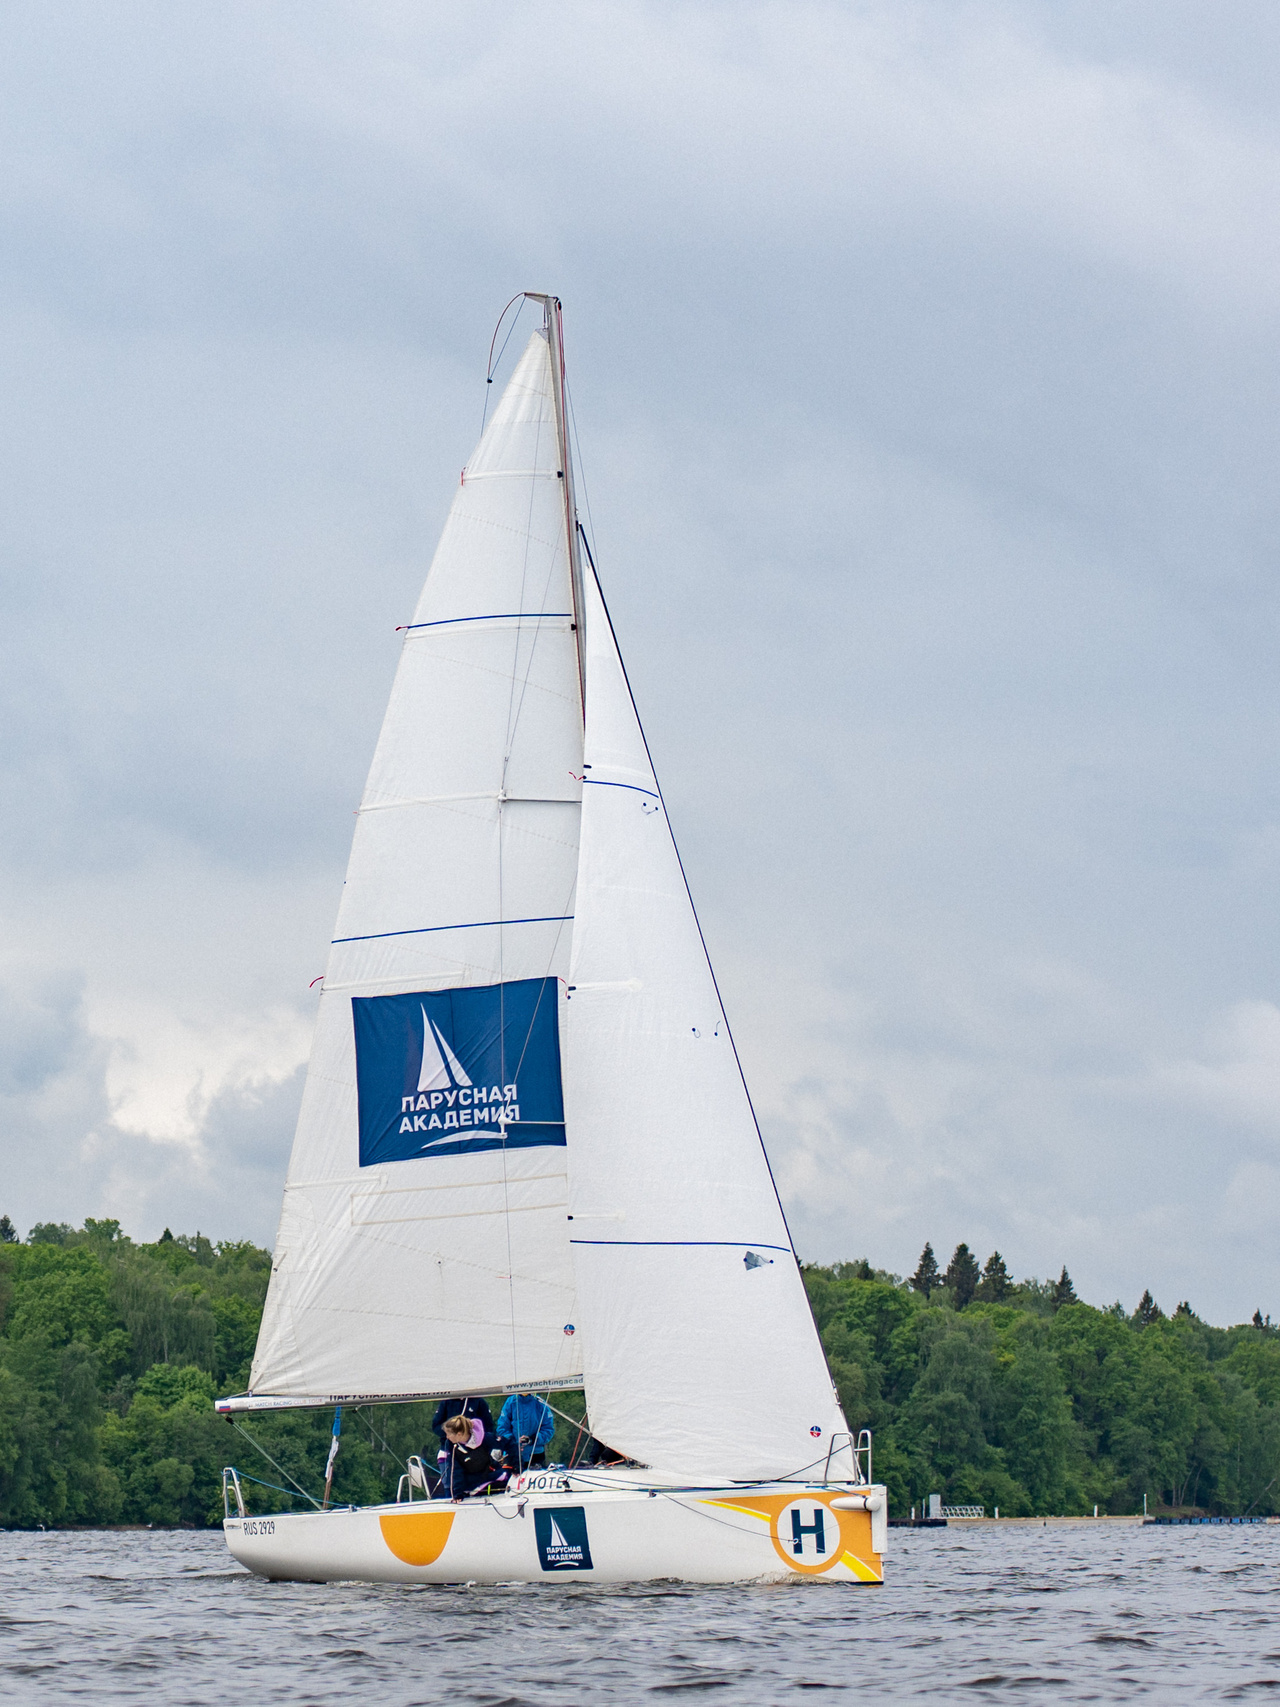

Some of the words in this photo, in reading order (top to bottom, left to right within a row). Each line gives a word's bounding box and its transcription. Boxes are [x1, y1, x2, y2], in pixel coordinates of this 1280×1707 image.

[401, 1084, 517, 1112] ПАРУСНАЯ
[399, 1104, 520, 1134] АКАДЕМИЯ
[528, 1476, 571, 1490] HOTE
[243, 1521, 258, 1536] RUS
[258, 1520, 275, 1535] 2929
[791, 1508, 826, 1554] H
[546, 1546, 581, 1554] ПАРУСНАЯ
[547, 1553, 583, 1561] АКАДЕМИЯ
